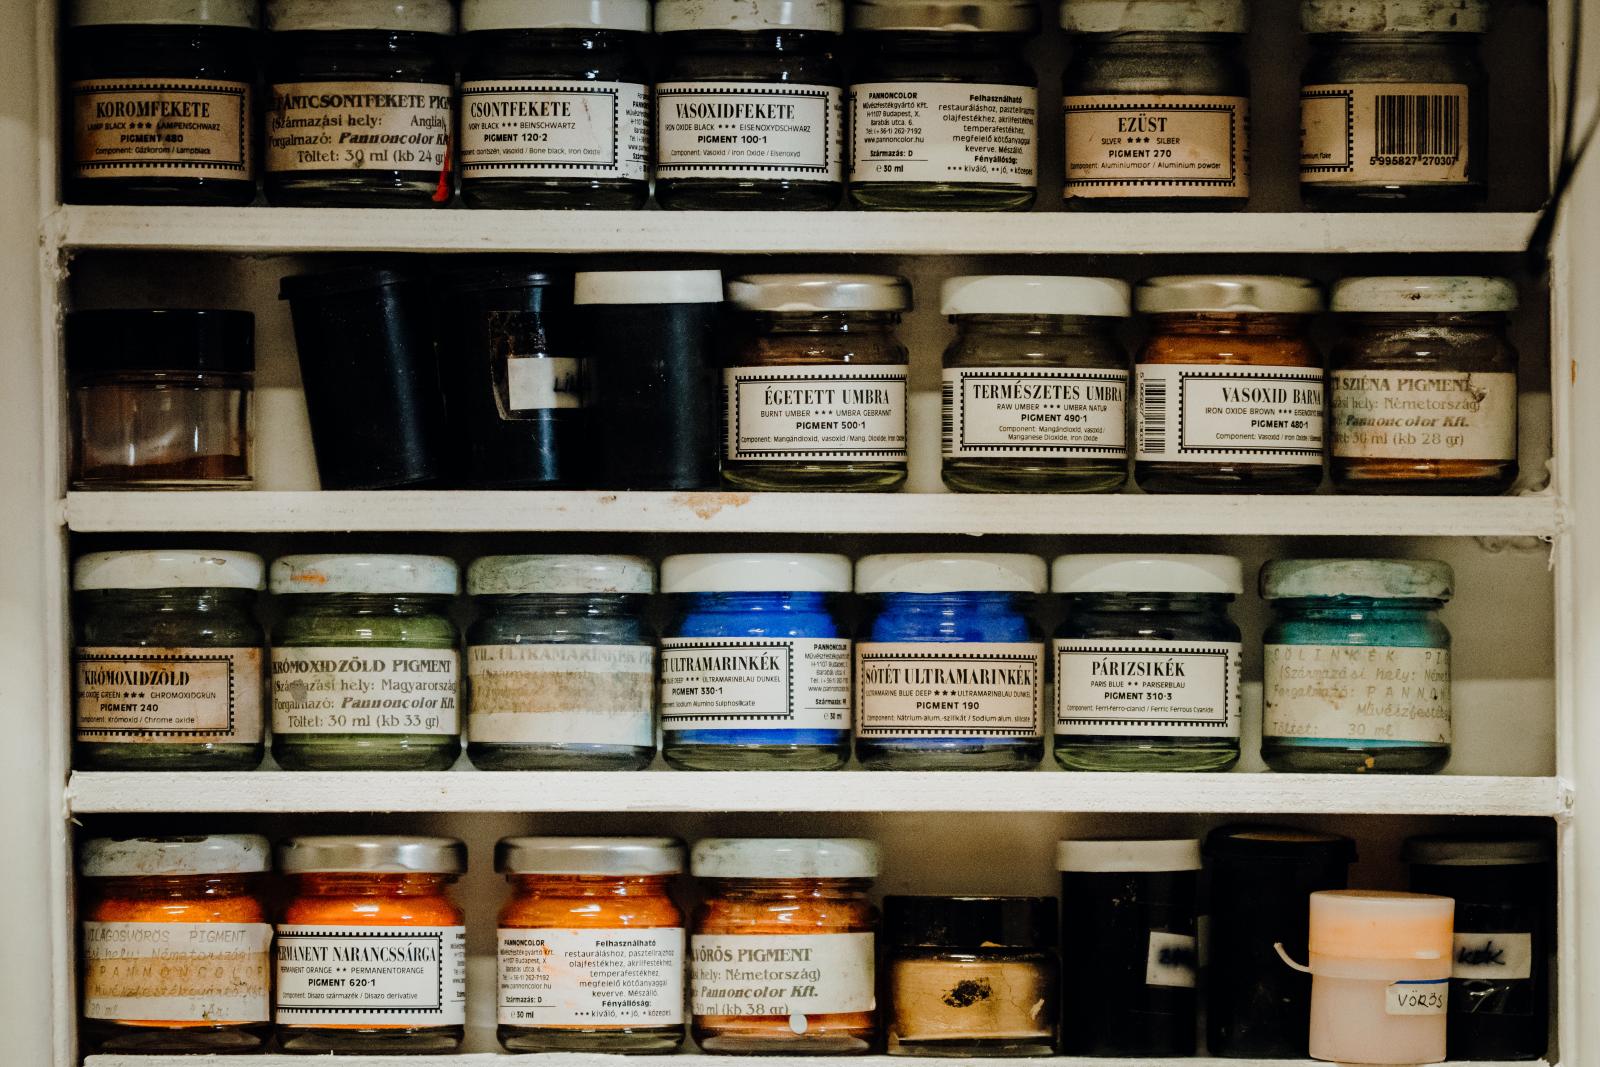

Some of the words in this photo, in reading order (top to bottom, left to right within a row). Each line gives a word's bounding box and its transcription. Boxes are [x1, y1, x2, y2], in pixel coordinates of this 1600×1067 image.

[970, 94, 1022, 103] Felhasználható
[96, 102, 210, 118] KOROMFEKETE
[471, 102, 571, 118] CSONTFEKETE
[676, 103, 794, 119] VASOXIDFEKETE
[348, 115, 382, 128] hely:
[740, 124, 811, 132] EISENOXYDSCHWARZ
[1118, 113, 1168, 132] EZÜST
[339, 132, 434, 144] Pannoncolor
[484, 134, 518, 142] PIGMENT
[344, 151, 364, 161] 30
[370, 151, 388, 161] ml
[418, 151, 432, 162] 24
[973, 381, 1079, 400] TERMÉSZETES
[1087, 386, 1122, 402] UMBRA
[1397, 379, 1471, 392] PIGMENT
[765, 386, 835, 405] ÉGETETT
[842, 389, 889, 404] UMBRA
[1222, 387, 1287, 403] VASOXID
[1251, 420, 1288, 428] PIGMENT
[1442, 416, 1469, 427] Kft.
[1372, 433, 1387, 443] ml
[1393, 433, 1416, 444] (kb
[1422, 434, 1441, 444] 28
[1446, 435, 1463, 447] gr)
[392, 660, 451, 672] PIGMENT
[671, 652, 780, 672] ULTRAMARINKÉK
[1092, 658, 1185, 676] PÁRIZSIKÉK
[905, 665, 1031, 685] ULTRAMARINKÉK
[341, 679, 374, 691] hely:
[100, 704, 137, 712] PIGMENT
[341, 697, 438, 708] Pannoncolor
[328, 715, 347, 726] 30
[352, 715, 370, 726] ml
[377, 715, 399, 728] (kb
[404, 715, 421, 726] 33
[190, 930, 246, 942] PIGMENT
[333, 943, 435, 962] NARANCSSÁRGA
[738, 948, 813, 962] PIGMENT
[726, 969, 820, 981] Németország)
[701, 987, 786, 998] Pannoncolor
[791, 986, 818, 997] Kft.
[706, 1004, 718, 1014] ml
[722, 1004, 742, 1015] (kb
[746, 1004, 764, 1014] 38
